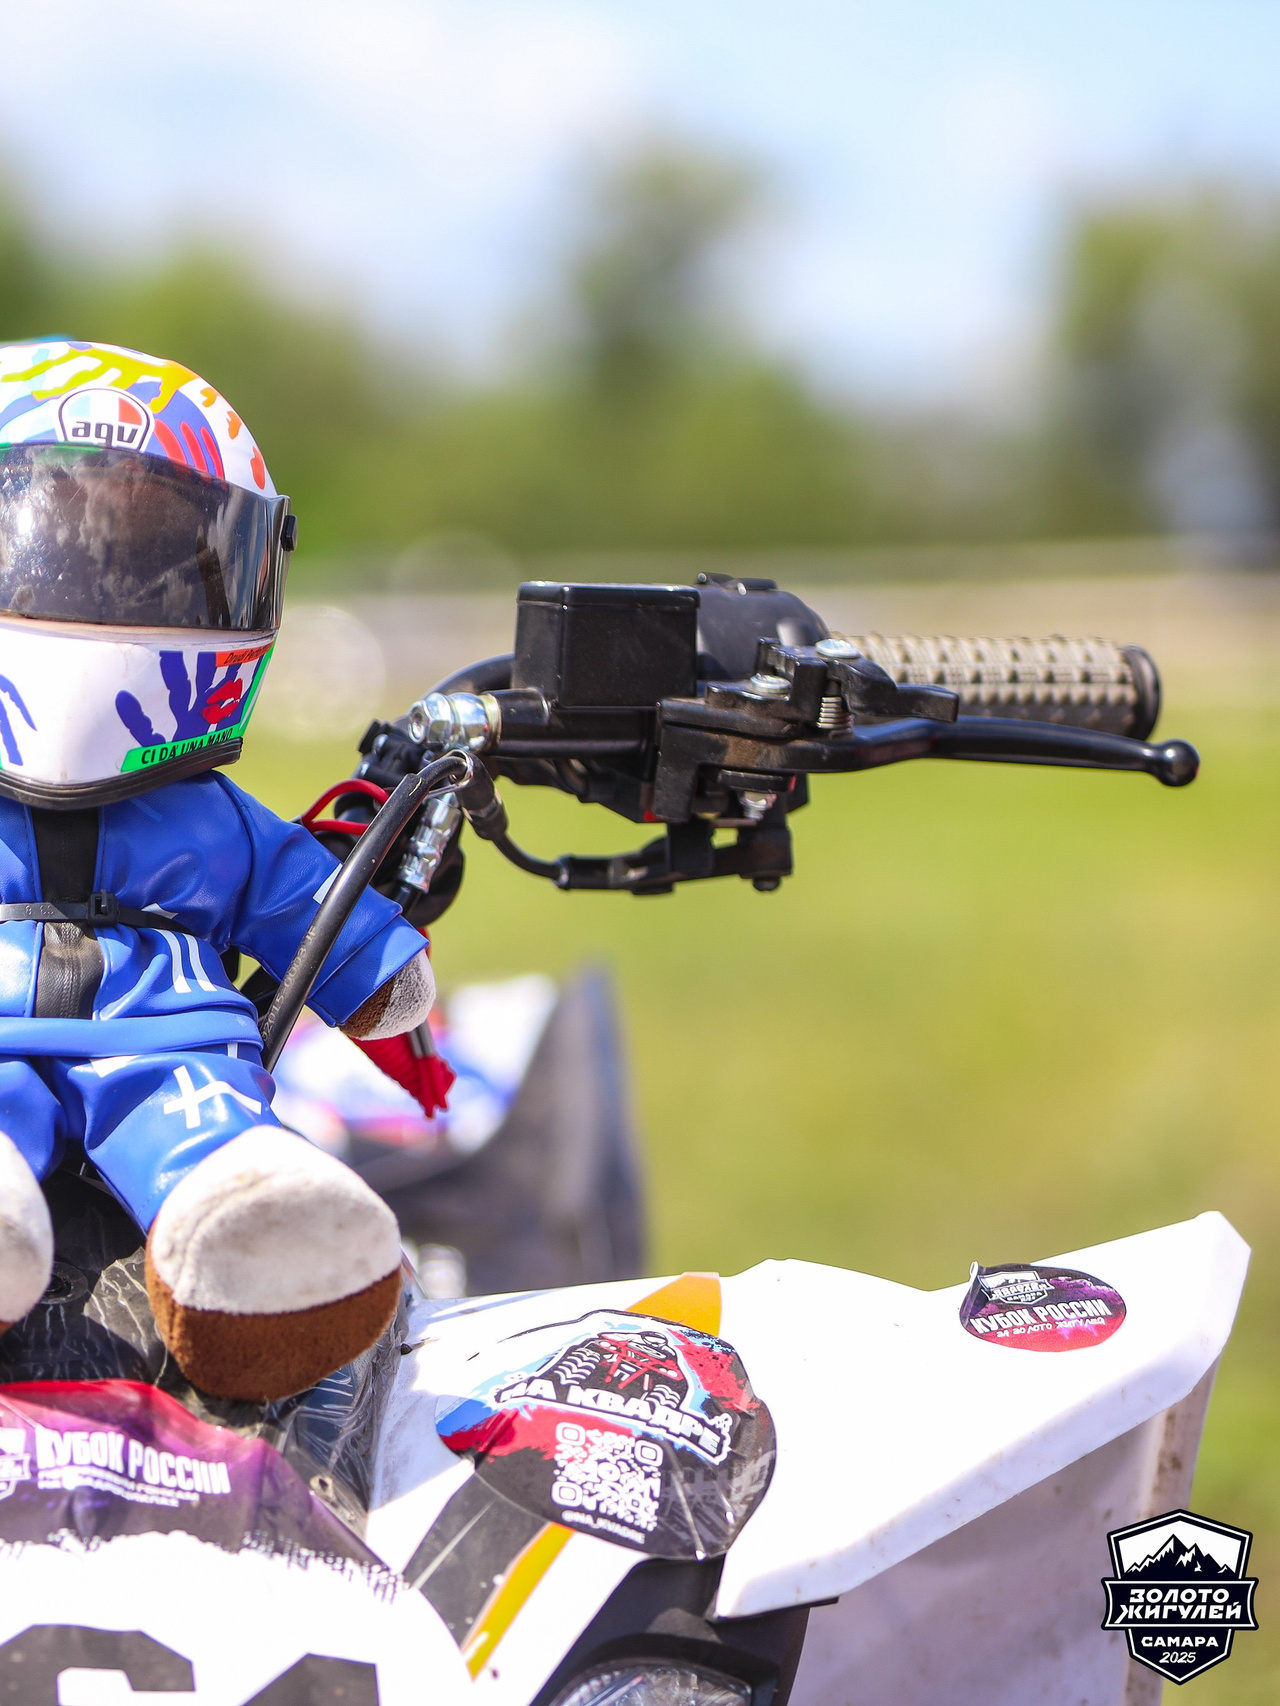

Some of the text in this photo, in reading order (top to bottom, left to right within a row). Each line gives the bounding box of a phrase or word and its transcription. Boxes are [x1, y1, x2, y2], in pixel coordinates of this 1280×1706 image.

[72, 418, 139, 447] agv
[141, 749, 155, 765] CI
[970, 1299, 1112, 1334] КУБОК РОССИИ
[567, 1385, 721, 1455] КВАДРЕ
[35, 1428, 125, 1473] КУБОК
[128, 1439, 231, 1494] РОССИИ
